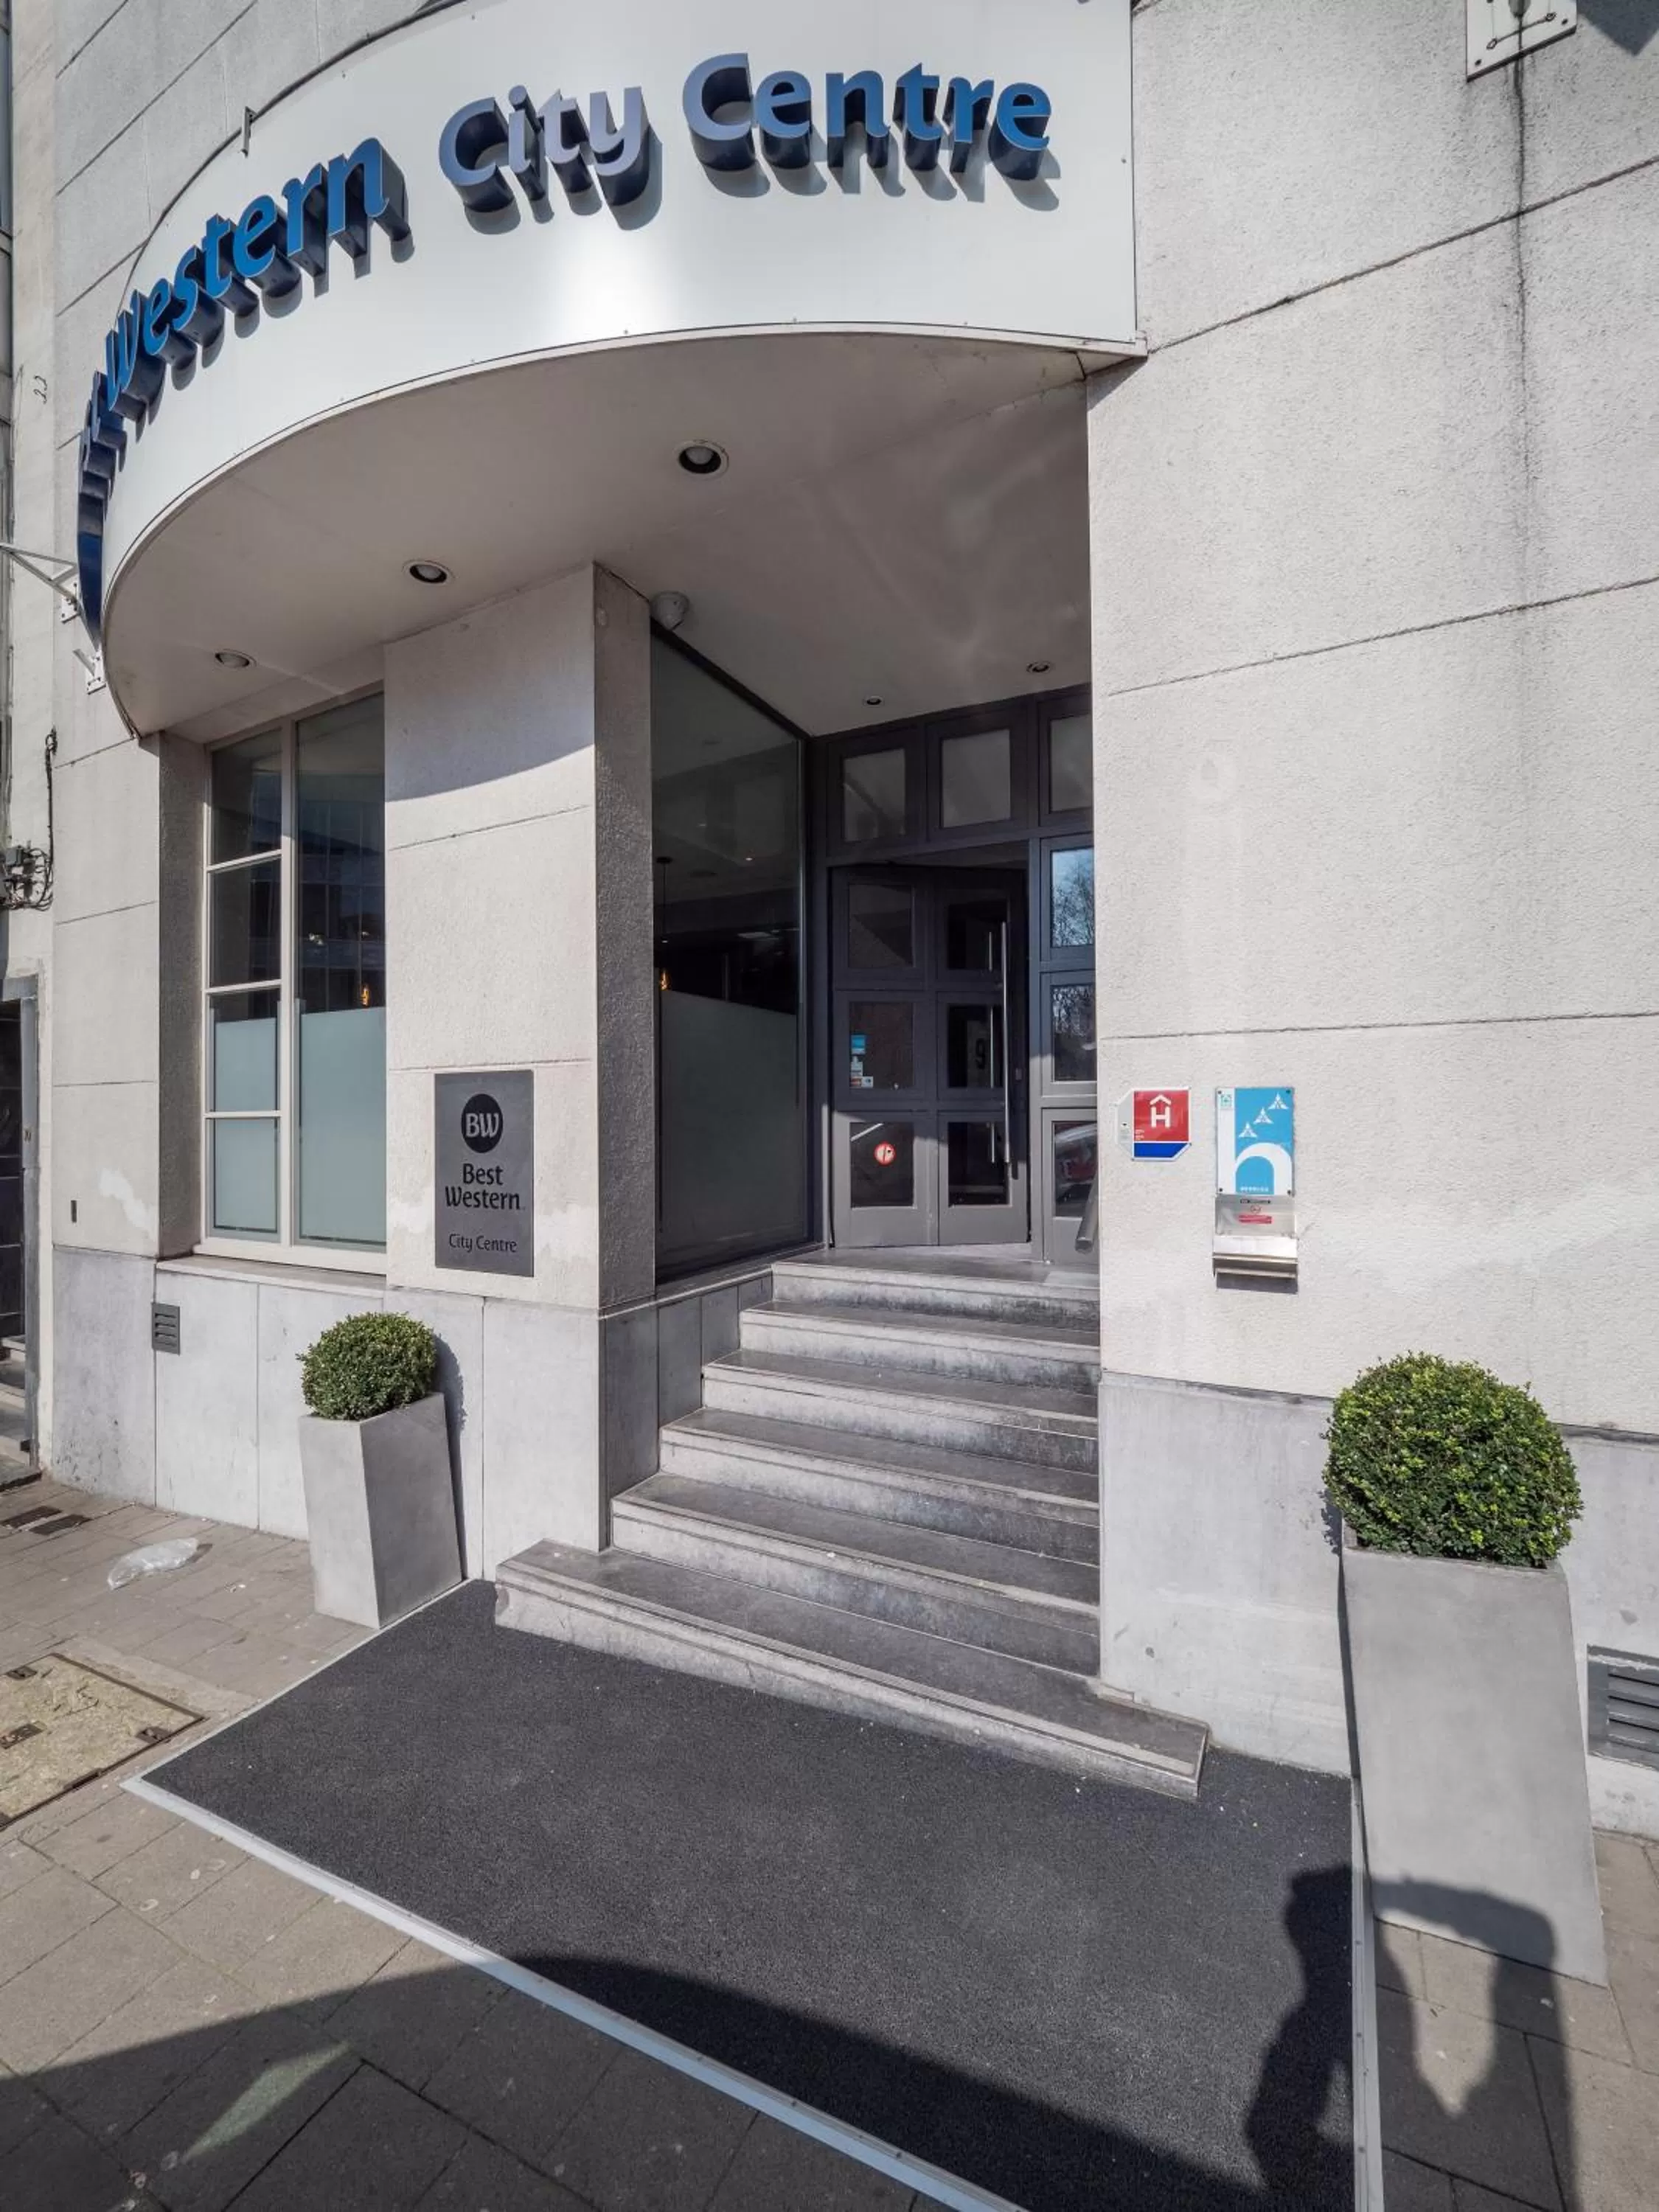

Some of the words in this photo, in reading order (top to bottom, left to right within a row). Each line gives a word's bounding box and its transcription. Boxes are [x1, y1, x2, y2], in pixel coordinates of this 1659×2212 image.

[105, 136, 391, 411] Western
[438, 85, 642, 176] City
[682, 52, 1052, 151] Centre
[465, 1112, 501, 1138] BW
[462, 1163, 504, 1186] Best
[445, 1185, 521, 1210] Western
[448, 1233, 473, 1252] City
[476, 1235, 518, 1253] Centre
